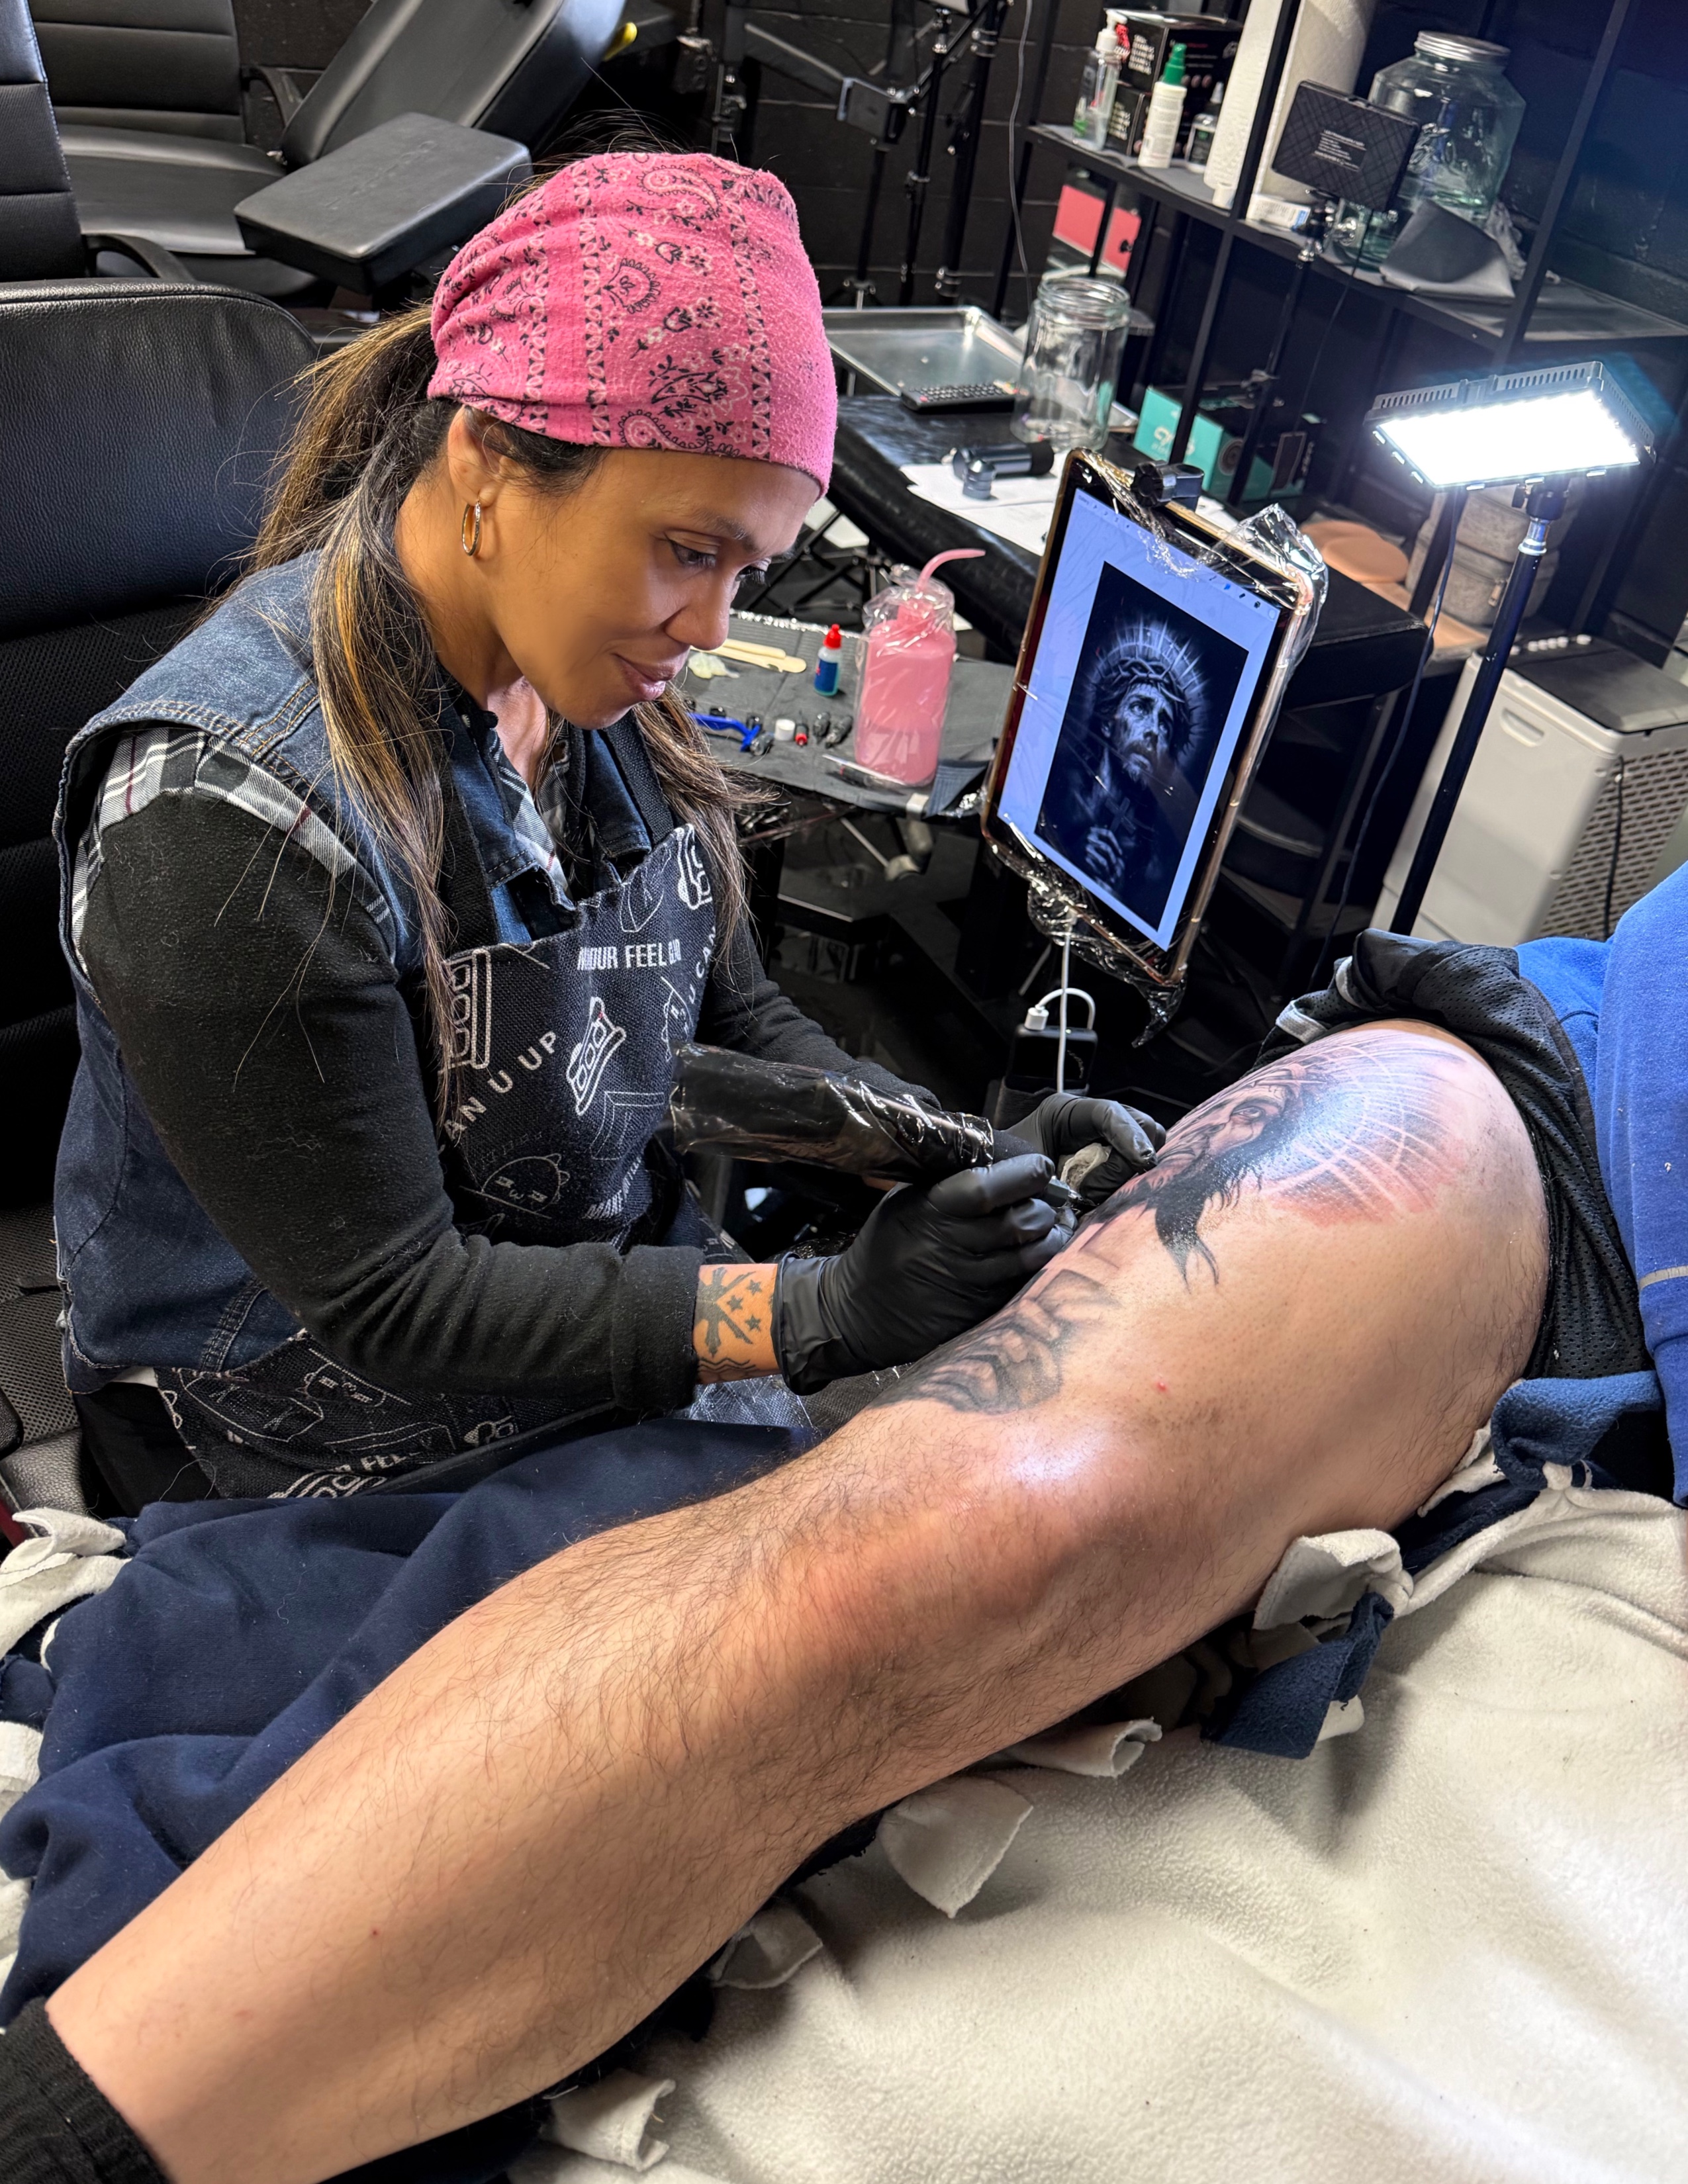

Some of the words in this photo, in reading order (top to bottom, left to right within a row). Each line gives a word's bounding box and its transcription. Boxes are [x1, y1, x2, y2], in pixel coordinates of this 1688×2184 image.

[625, 942, 667, 969] FEEL
[487, 1069, 513, 1093] U
[517, 1030, 557, 1071] UP
